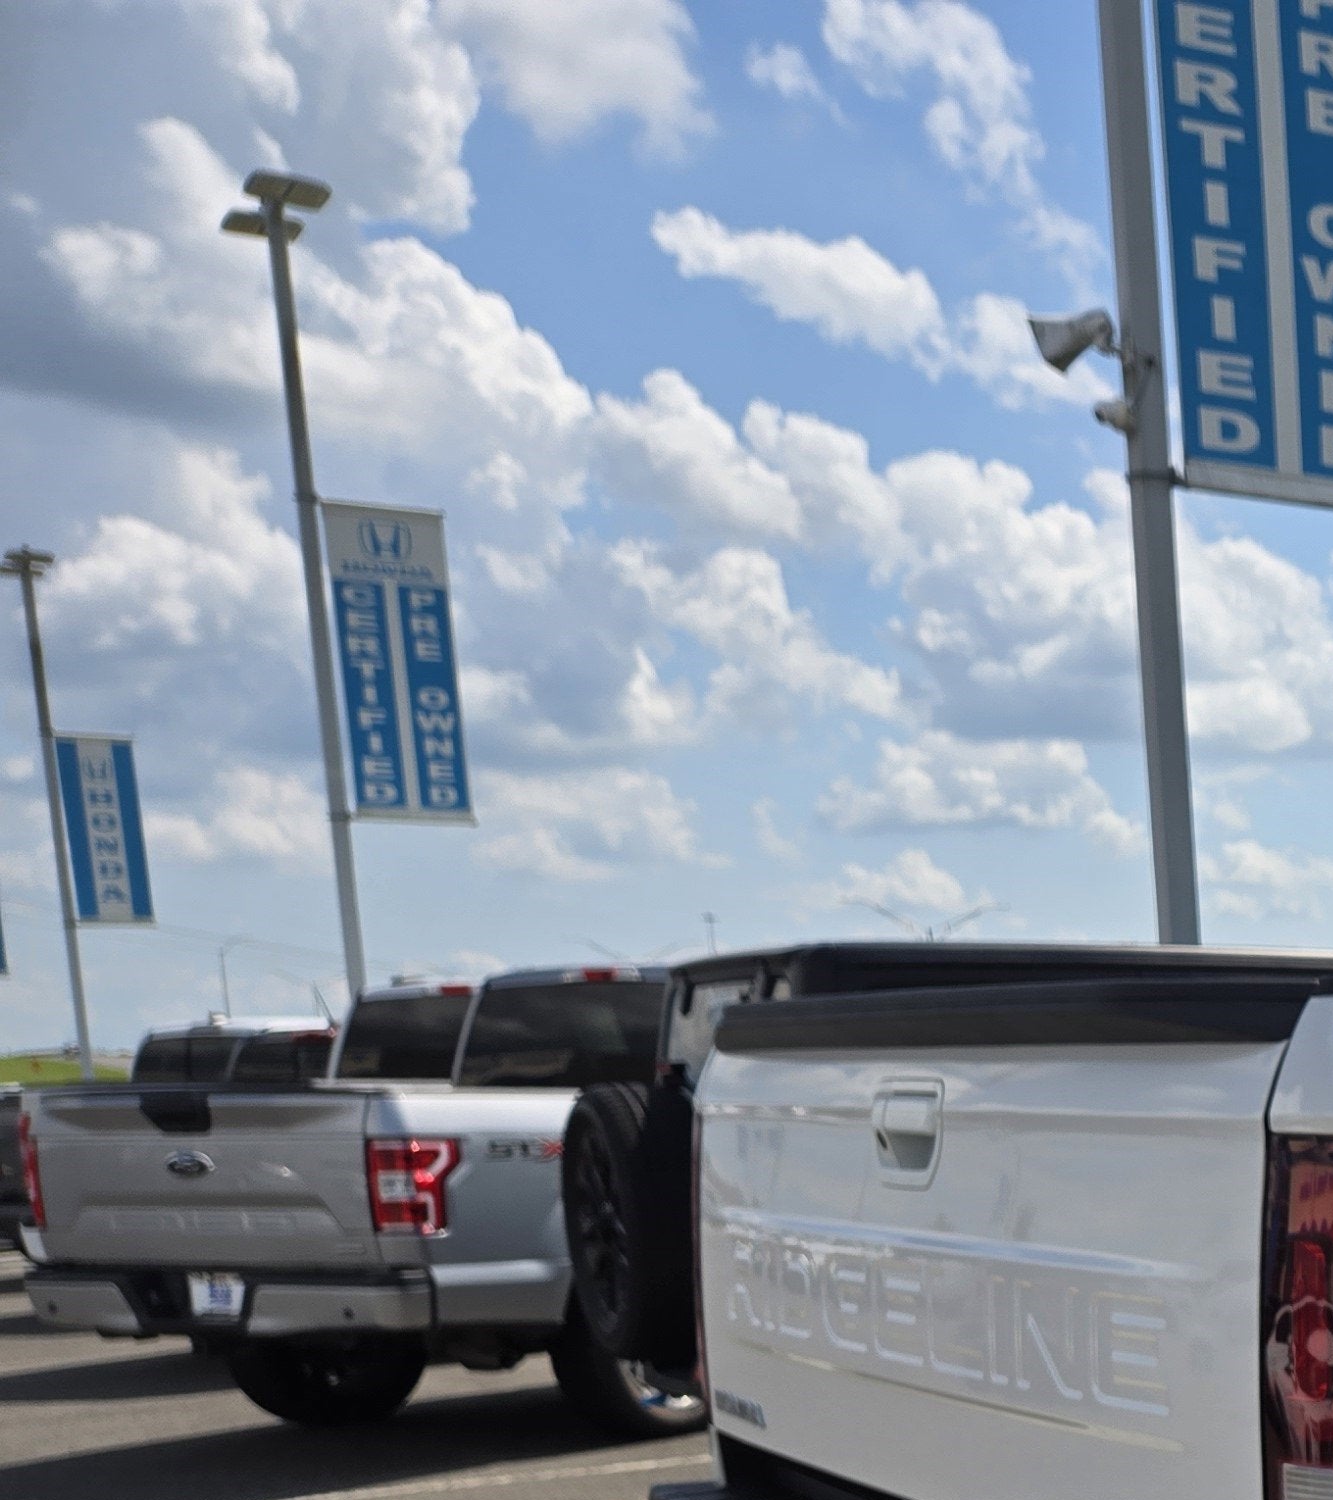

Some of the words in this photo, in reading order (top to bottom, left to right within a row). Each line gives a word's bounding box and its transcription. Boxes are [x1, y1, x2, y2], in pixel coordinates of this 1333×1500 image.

[407, 588, 444, 663] PRE
[339, 582, 399, 804] CERTIFIED
[416, 685, 460, 806] OWNED
